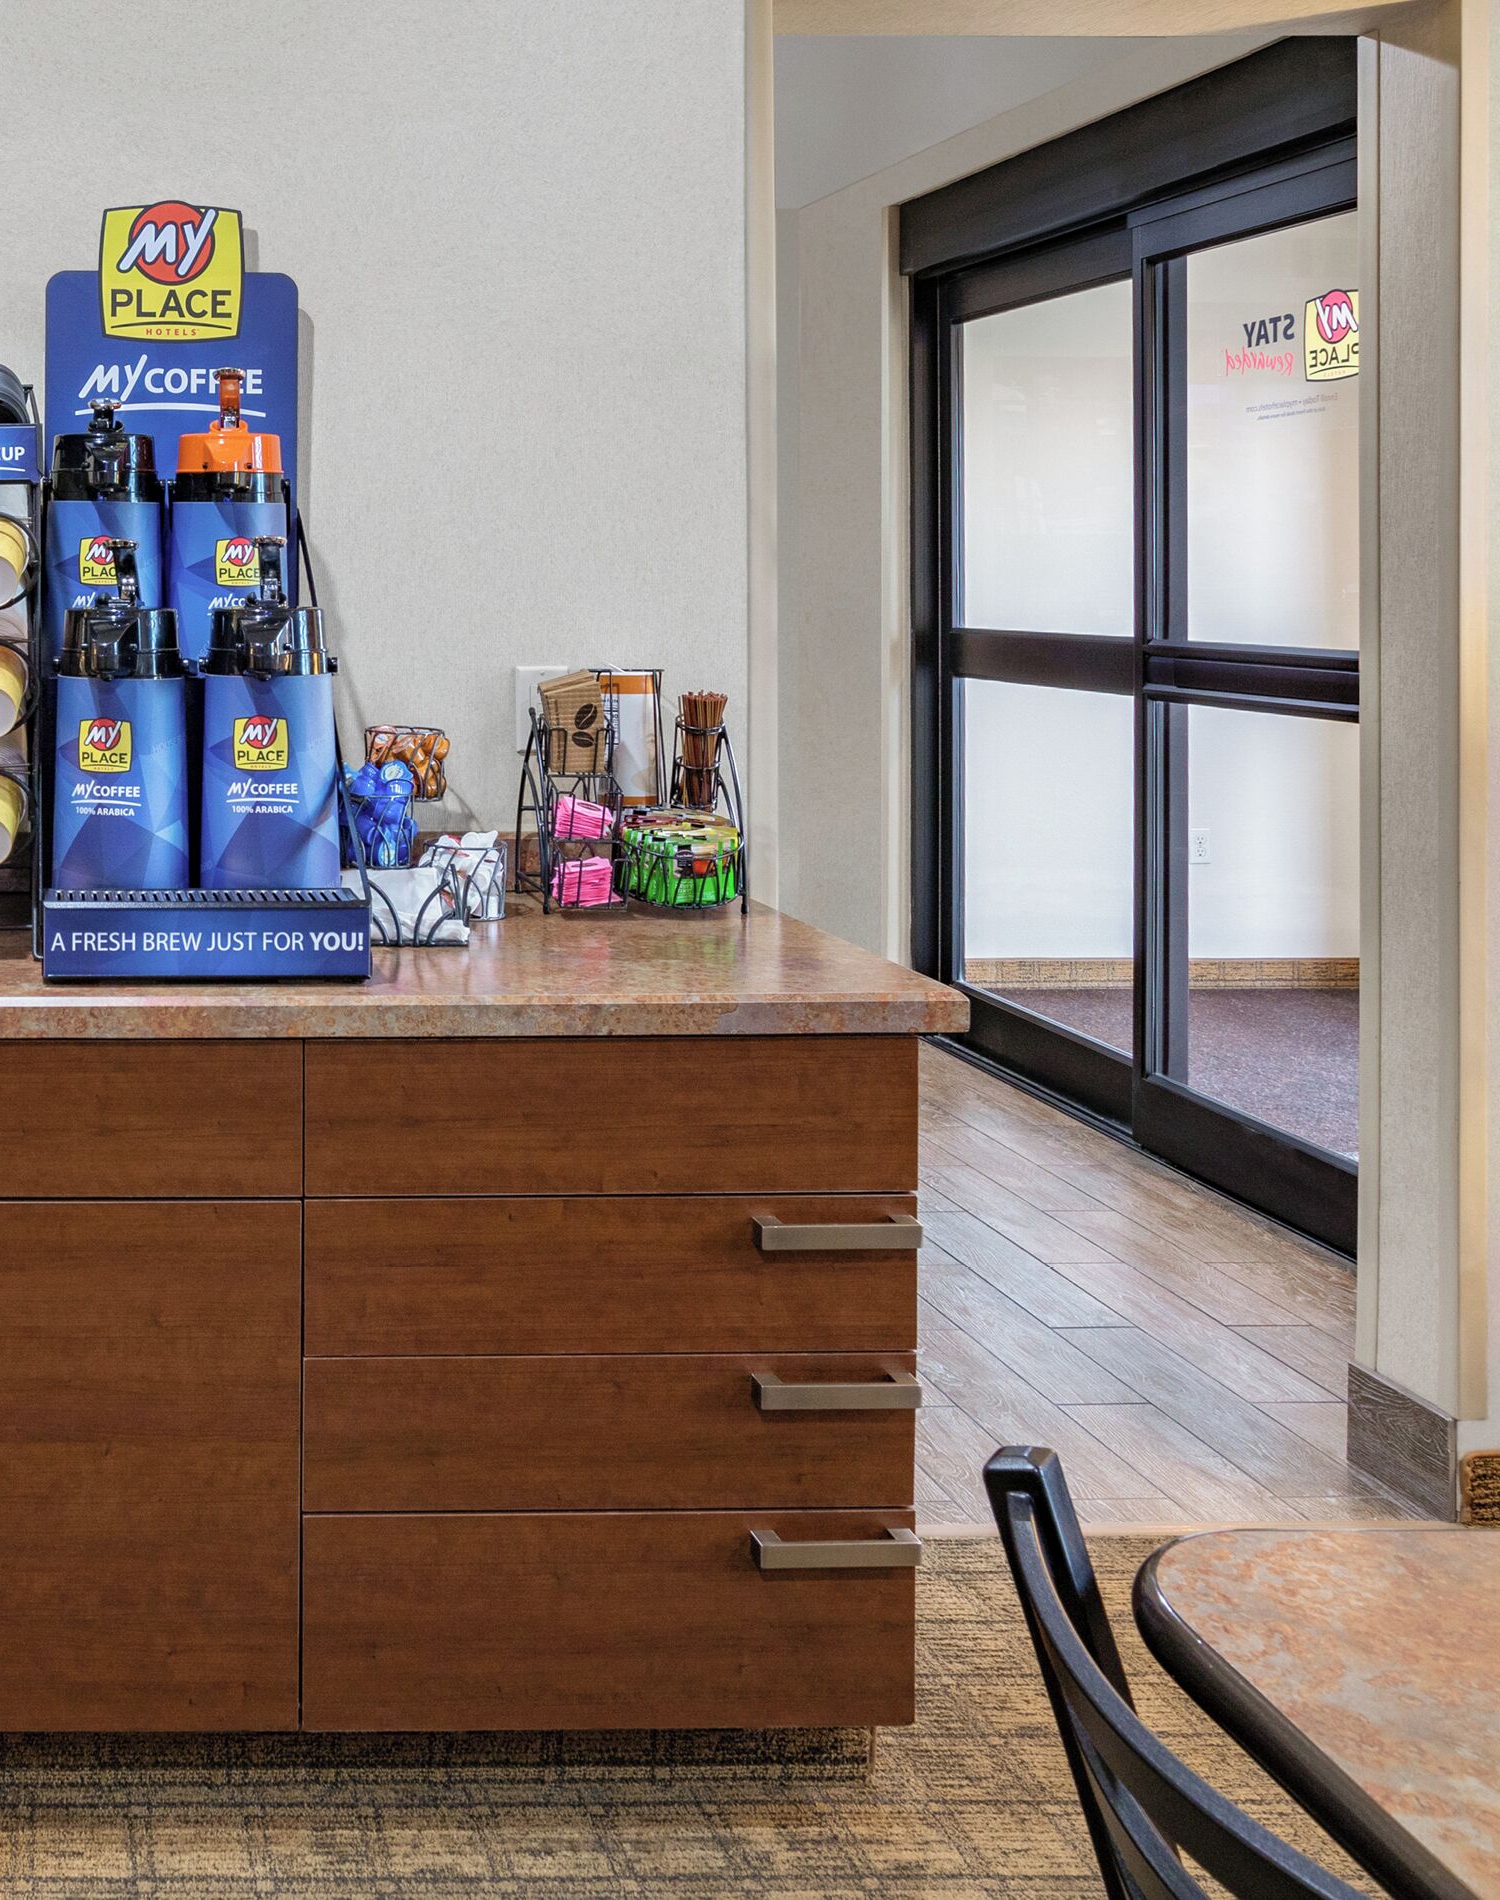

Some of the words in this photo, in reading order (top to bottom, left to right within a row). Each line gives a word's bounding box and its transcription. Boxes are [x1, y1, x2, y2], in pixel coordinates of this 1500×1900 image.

[110, 288, 233, 319] PLACE
[145, 328, 198, 336] HOTELS
[82, 566, 117, 577] PLAC
[81, 751, 128, 764] PLACE
[237, 750, 285, 762] PLACE
[75, 806, 96, 815] 100%
[96, 807, 135, 817] ARABICA
[231, 805, 254, 814] 100%
[254, 805, 294, 814] ARABICA
[50, 931, 66, 952] A
[71, 931, 136, 952] FRESH
[142, 931, 203, 952] BREW
[206, 931, 258, 952] JUST
[262, 931, 304, 952] FOR
[309, 931, 364, 952] YOU!
